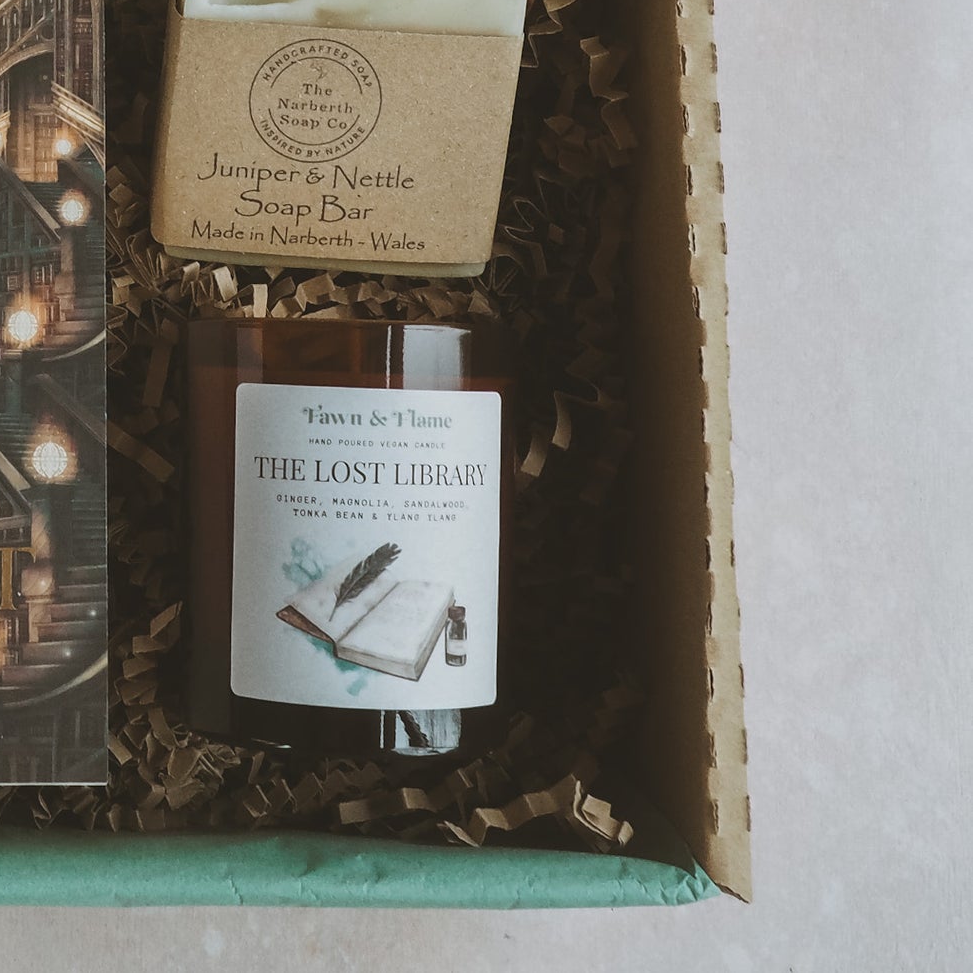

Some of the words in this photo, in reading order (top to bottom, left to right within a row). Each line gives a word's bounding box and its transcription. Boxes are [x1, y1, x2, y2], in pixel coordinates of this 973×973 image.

[262, 45, 349, 81] HANDCRAFTED
[351, 59, 373, 87] SOAP
[302, 83, 333, 96] The
[277, 97, 353, 114] Narberth
[279, 114, 320, 130] Soap
[327, 117, 348, 130] Co
[260, 119, 302, 155] INSPIRED
[306, 149, 321, 157] BY
[325, 126, 366, 156] NATURE
[197, 152, 301, 192] Juniper
[305, 167, 325, 185] &
[332, 165, 415, 190] Nettle
[234, 189, 312, 226] Soap
[318, 194, 374, 223] Bar
[191, 220, 245, 241] Made
[249, 227, 264, 241] in
[270, 225, 354, 247] Narberth
[370, 231, 426, 252] Wales
[301, 404, 363, 427] Fawn
[369, 410, 388, 428] &
[393, 408, 453, 429] Flame
[308, 438, 332, 446] HAND
[338, 439, 374, 448] POURED
[380, 440, 409, 449] VEGAN
[254, 455, 306, 482] THE
[314, 459, 386, 484] LOST
[394, 462, 488, 487] LIBRARY
[276, 494, 324, 506] GINGER,
[332, 498, 395, 509] MAGNOLIA,
[293, 508, 328, 518] TONKA
[336, 511, 364, 520] BEAN
[371, 512, 378, 521] &
[387, 513, 420, 522] YLANG
[427, 514, 457, 522] YLANG
